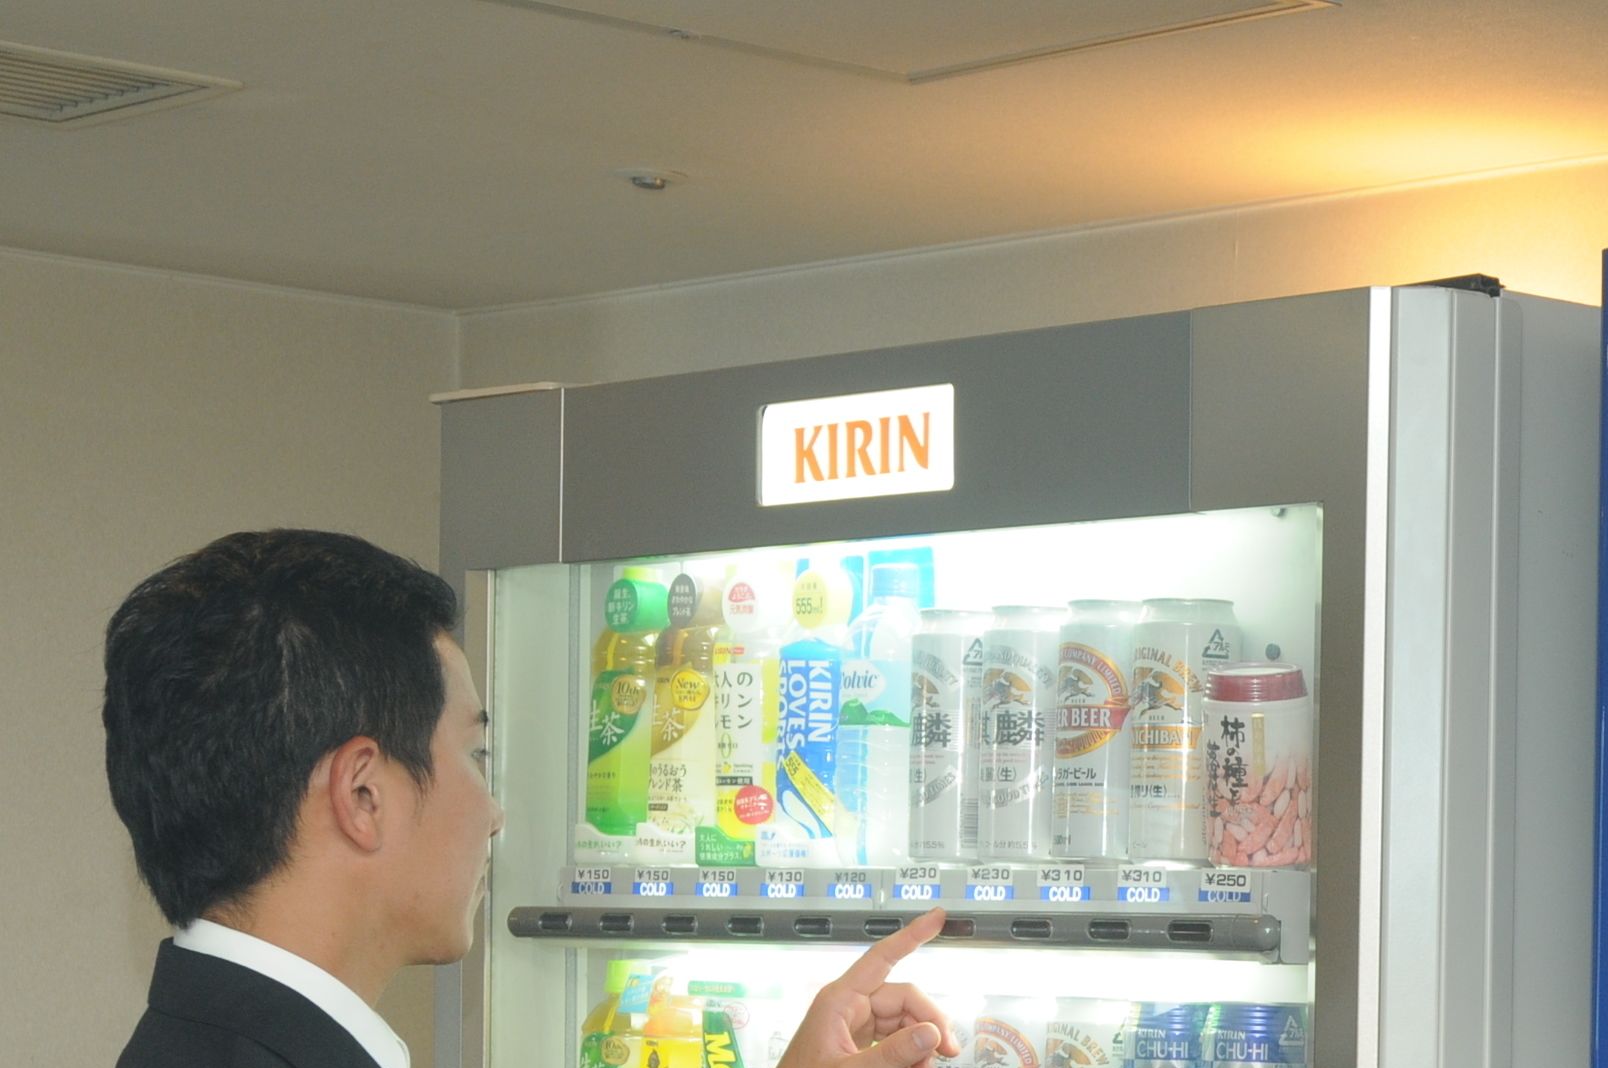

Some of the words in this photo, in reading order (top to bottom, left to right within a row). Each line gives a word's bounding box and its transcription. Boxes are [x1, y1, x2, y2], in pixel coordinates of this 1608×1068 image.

[793, 412, 931, 484] KIRIN
[786, 660, 808, 750] LOVES
[808, 660, 832, 743] KIRIN
[578, 870, 609, 880] ¥150
[768, 872, 802, 882] ¥130
[900, 867, 936, 879] ¥230
[972, 869, 1009, 880] ¥230
[1041, 870, 1082, 881] ¥310
[1122, 870, 1162, 882] ¥310
[1206, 873, 1246, 886] ¥250
[703, 884, 730, 896] COLD
[902, 885, 932, 899] COLD
[1127, 888, 1160, 902] COLD
[1138, 1028, 1165, 1040] KIRIN
[1218, 1028, 1245, 1040] KIRIN
